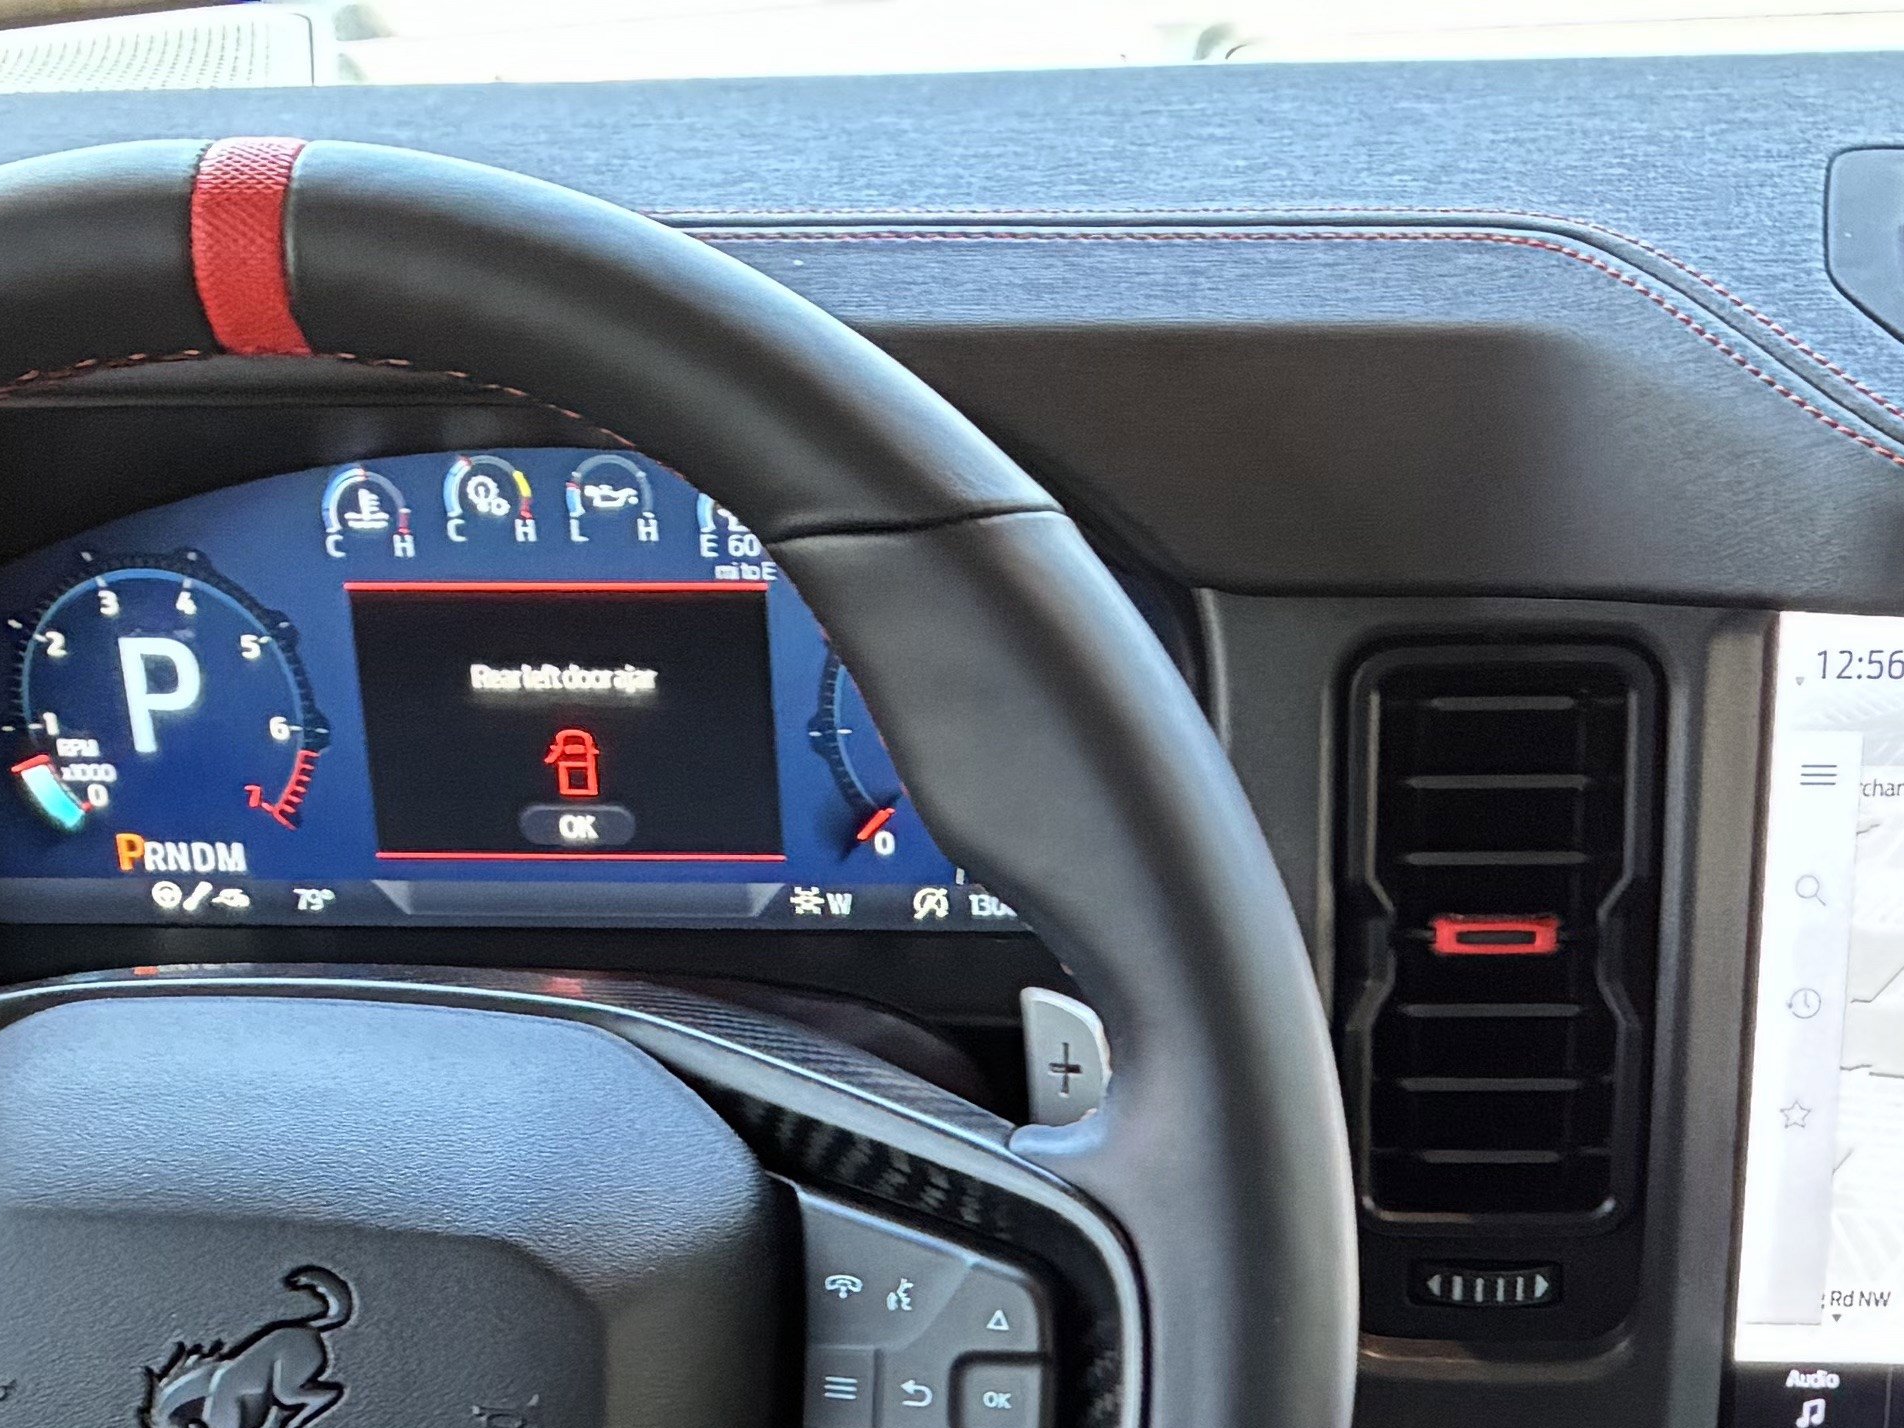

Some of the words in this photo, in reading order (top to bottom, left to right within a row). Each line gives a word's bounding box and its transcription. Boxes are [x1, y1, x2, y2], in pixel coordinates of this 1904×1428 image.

[447, 519, 466, 542] C
[515, 519, 537, 542] H
[570, 519, 589, 542] L
[638, 518, 659, 542] H
[326, 535, 346, 558] C
[393, 535, 415, 558] H
[700, 533, 719, 558] E
[98, 590, 120, 616] 3
[176, 591, 196, 615] 4
[46, 631, 67, 658] 2
[240, 634, 262, 659] 5
[562, 663, 614, 689] door
[118, 637, 201, 753] P
[43, 711, 59, 736] 1
[269, 716, 291, 741] 6
[87, 784, 109, 807] 0
[558, 815, 598, 840] OK
[873, 831, 895, 856] 0
[826, 893, 852, 916] W
[1830, 1290, 1854, 1307] Rd
[1859, 1290, 1891, 1307] NW
[1785, 1369, 1840, 1389] Audio
[983, 1391, 1012, 1409] OK
